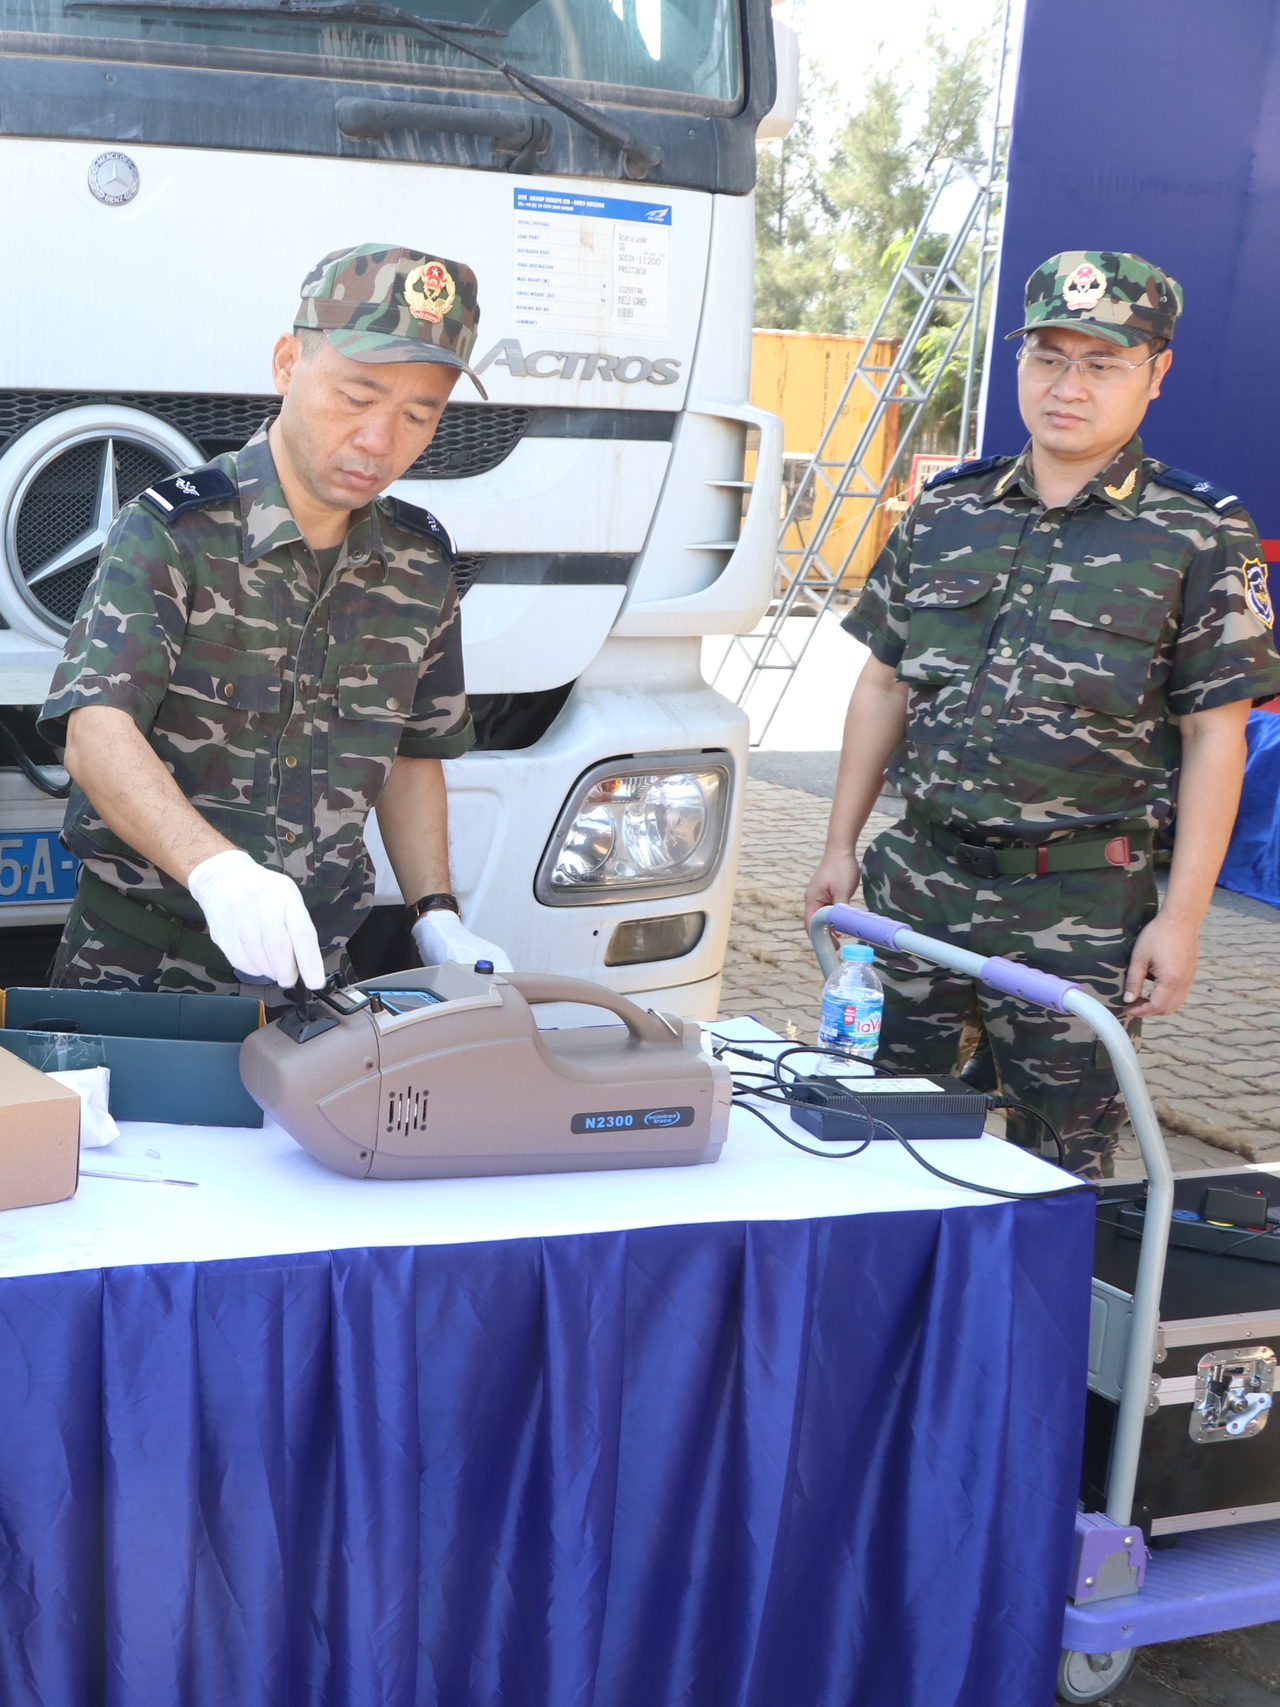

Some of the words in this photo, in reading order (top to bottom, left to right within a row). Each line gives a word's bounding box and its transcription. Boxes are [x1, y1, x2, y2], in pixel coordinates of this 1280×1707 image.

[96, 153, 132, 167] MERCEDES
[638, 256, 661, 266] 11200
[471, 338, 682, 385] ACTROS
[585, 1115, 634, 1129] N2300
